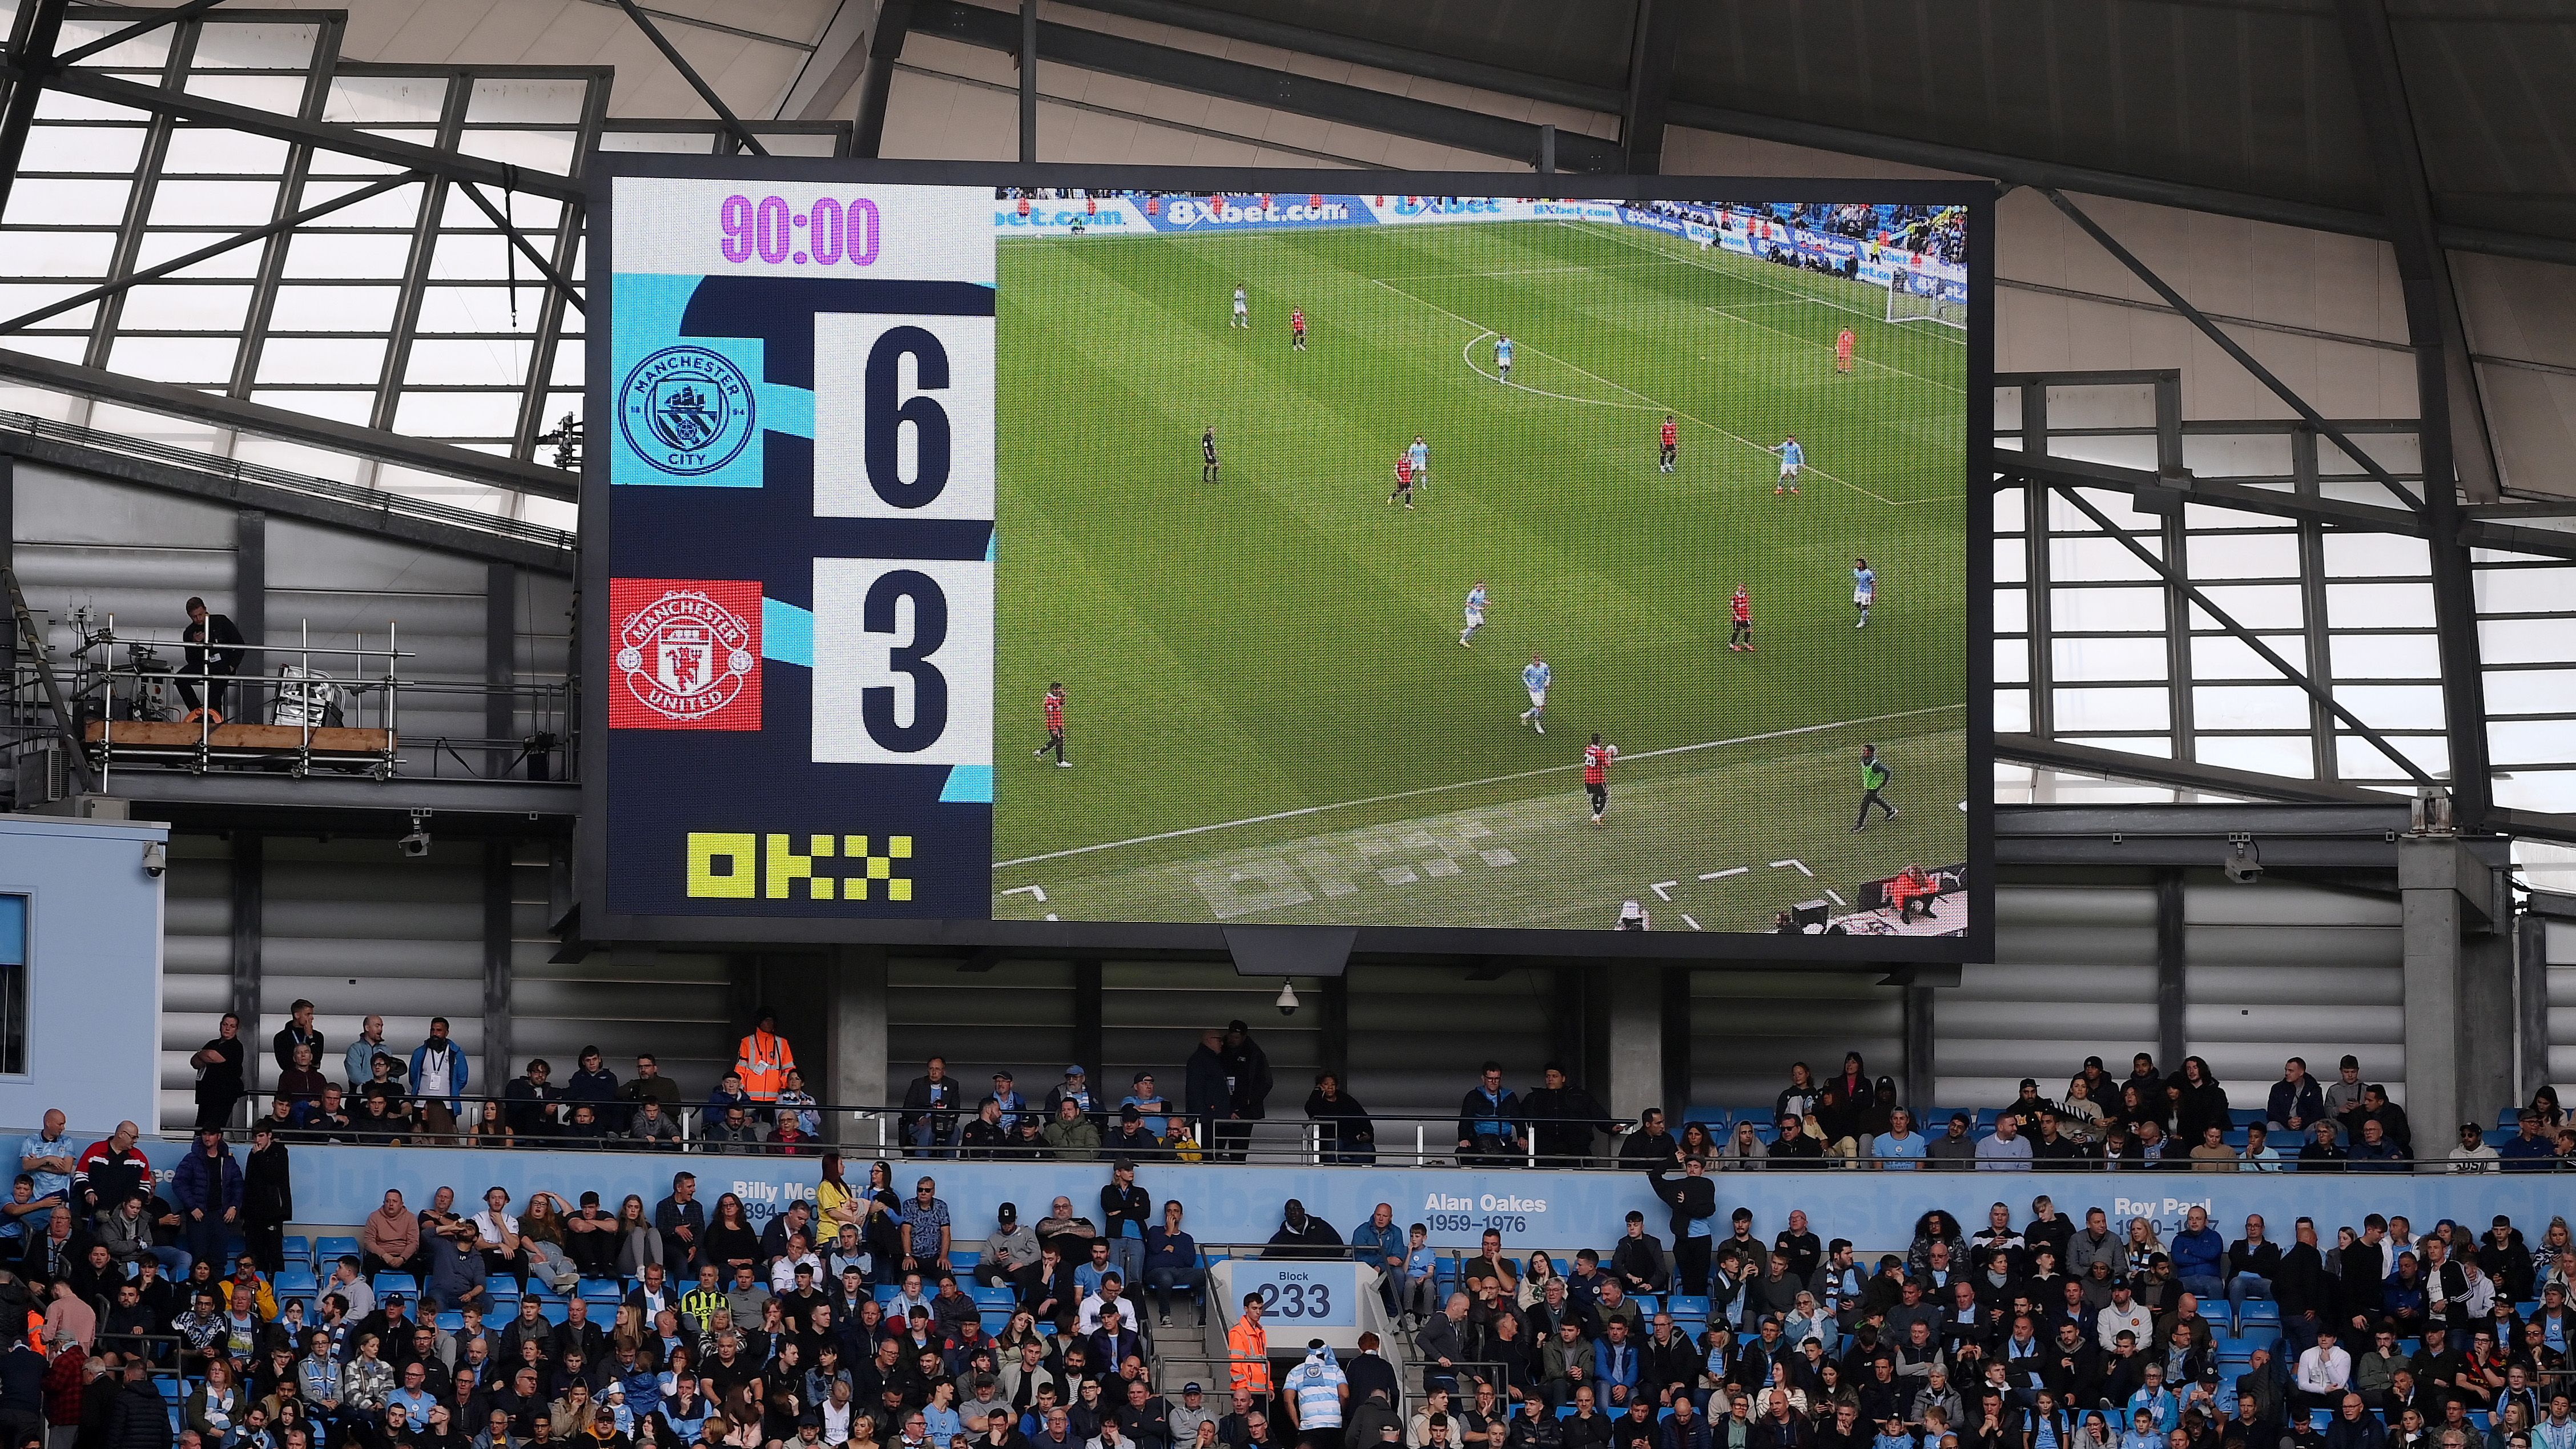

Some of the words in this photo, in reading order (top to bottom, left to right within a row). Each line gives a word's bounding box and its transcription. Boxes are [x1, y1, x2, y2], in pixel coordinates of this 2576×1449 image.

[721, 195, 879, 267] 90:00
[634, 355, 740, 397] MANCHESTER
[864, 325, 951, 509] 6
[667, 453, 707, 466] CITY
[633, 601, 739, 642] MANCHESTER
[862, 569, 948, 753] 3
[648, 690, 723, 711] UNITED
[686, 832, 912, 901] OKX
[732, 1181, 778, 1202] Billy
[1424, 1193, 1473, 1212] Alan
[1479, 1193, 1547, 1213] Oakes
[2114, 1197, 2156, 1219] Roy
[1426, 1214, 1526, 1233] 1959–1976
[1278, 1271, 1309, 1282] Block
[1258, 1283, 1330, 1318] 233
